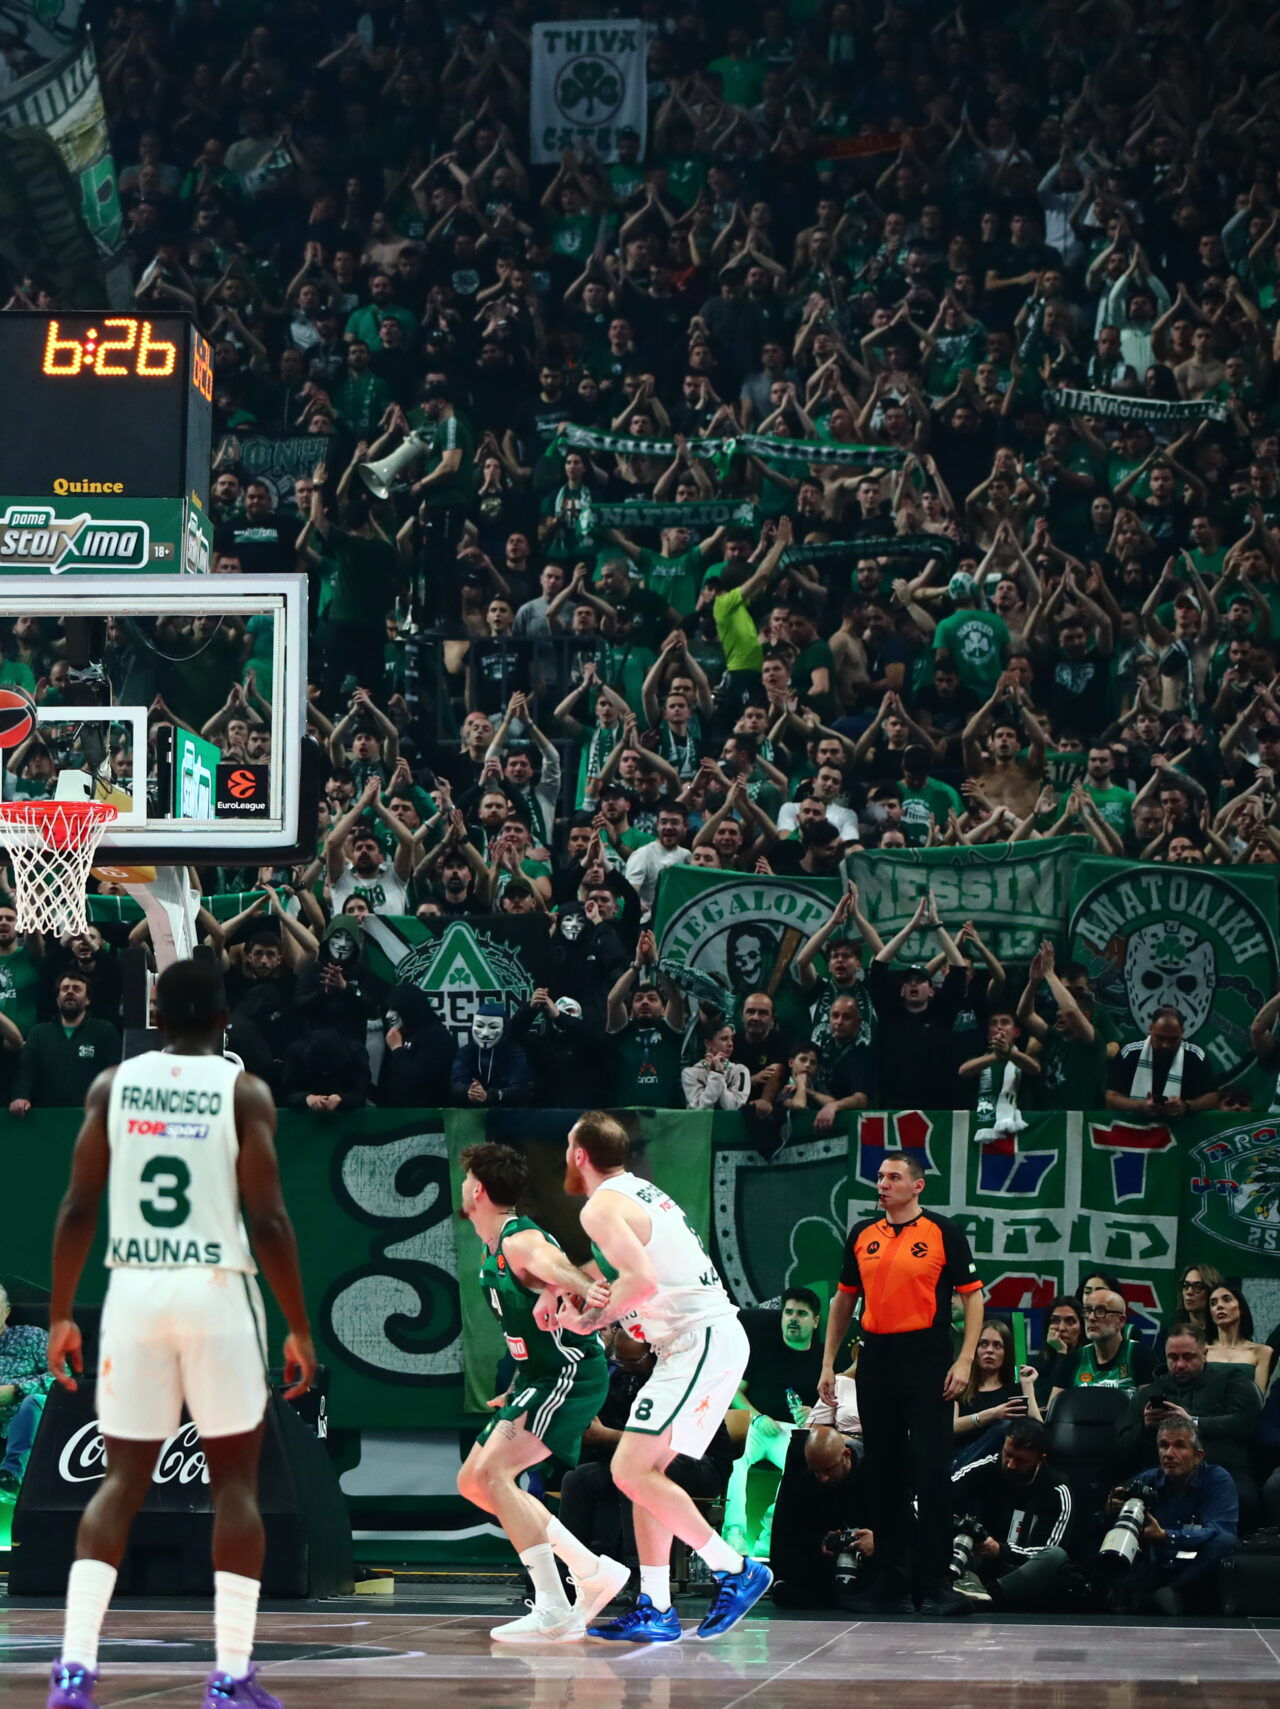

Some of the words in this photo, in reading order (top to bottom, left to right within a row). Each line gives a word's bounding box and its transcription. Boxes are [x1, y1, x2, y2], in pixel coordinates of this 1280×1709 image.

[43, 317, 177, 376] 6:26
[53, 477, 125, 496] Quince
[11, 512, 47, 527] pame
[154, 545, 170, 558] 18+
[217, 801, 266, 811] EuroLeague
[998, 929, 1035, 956] 13
[121, 1086, 221, 1116] FRANCISCO
[139, 1155, 191, 1229] 3
[111, 1236, 221, 1265] KAUNAS
[634, 1398, 654, 1421] 8
